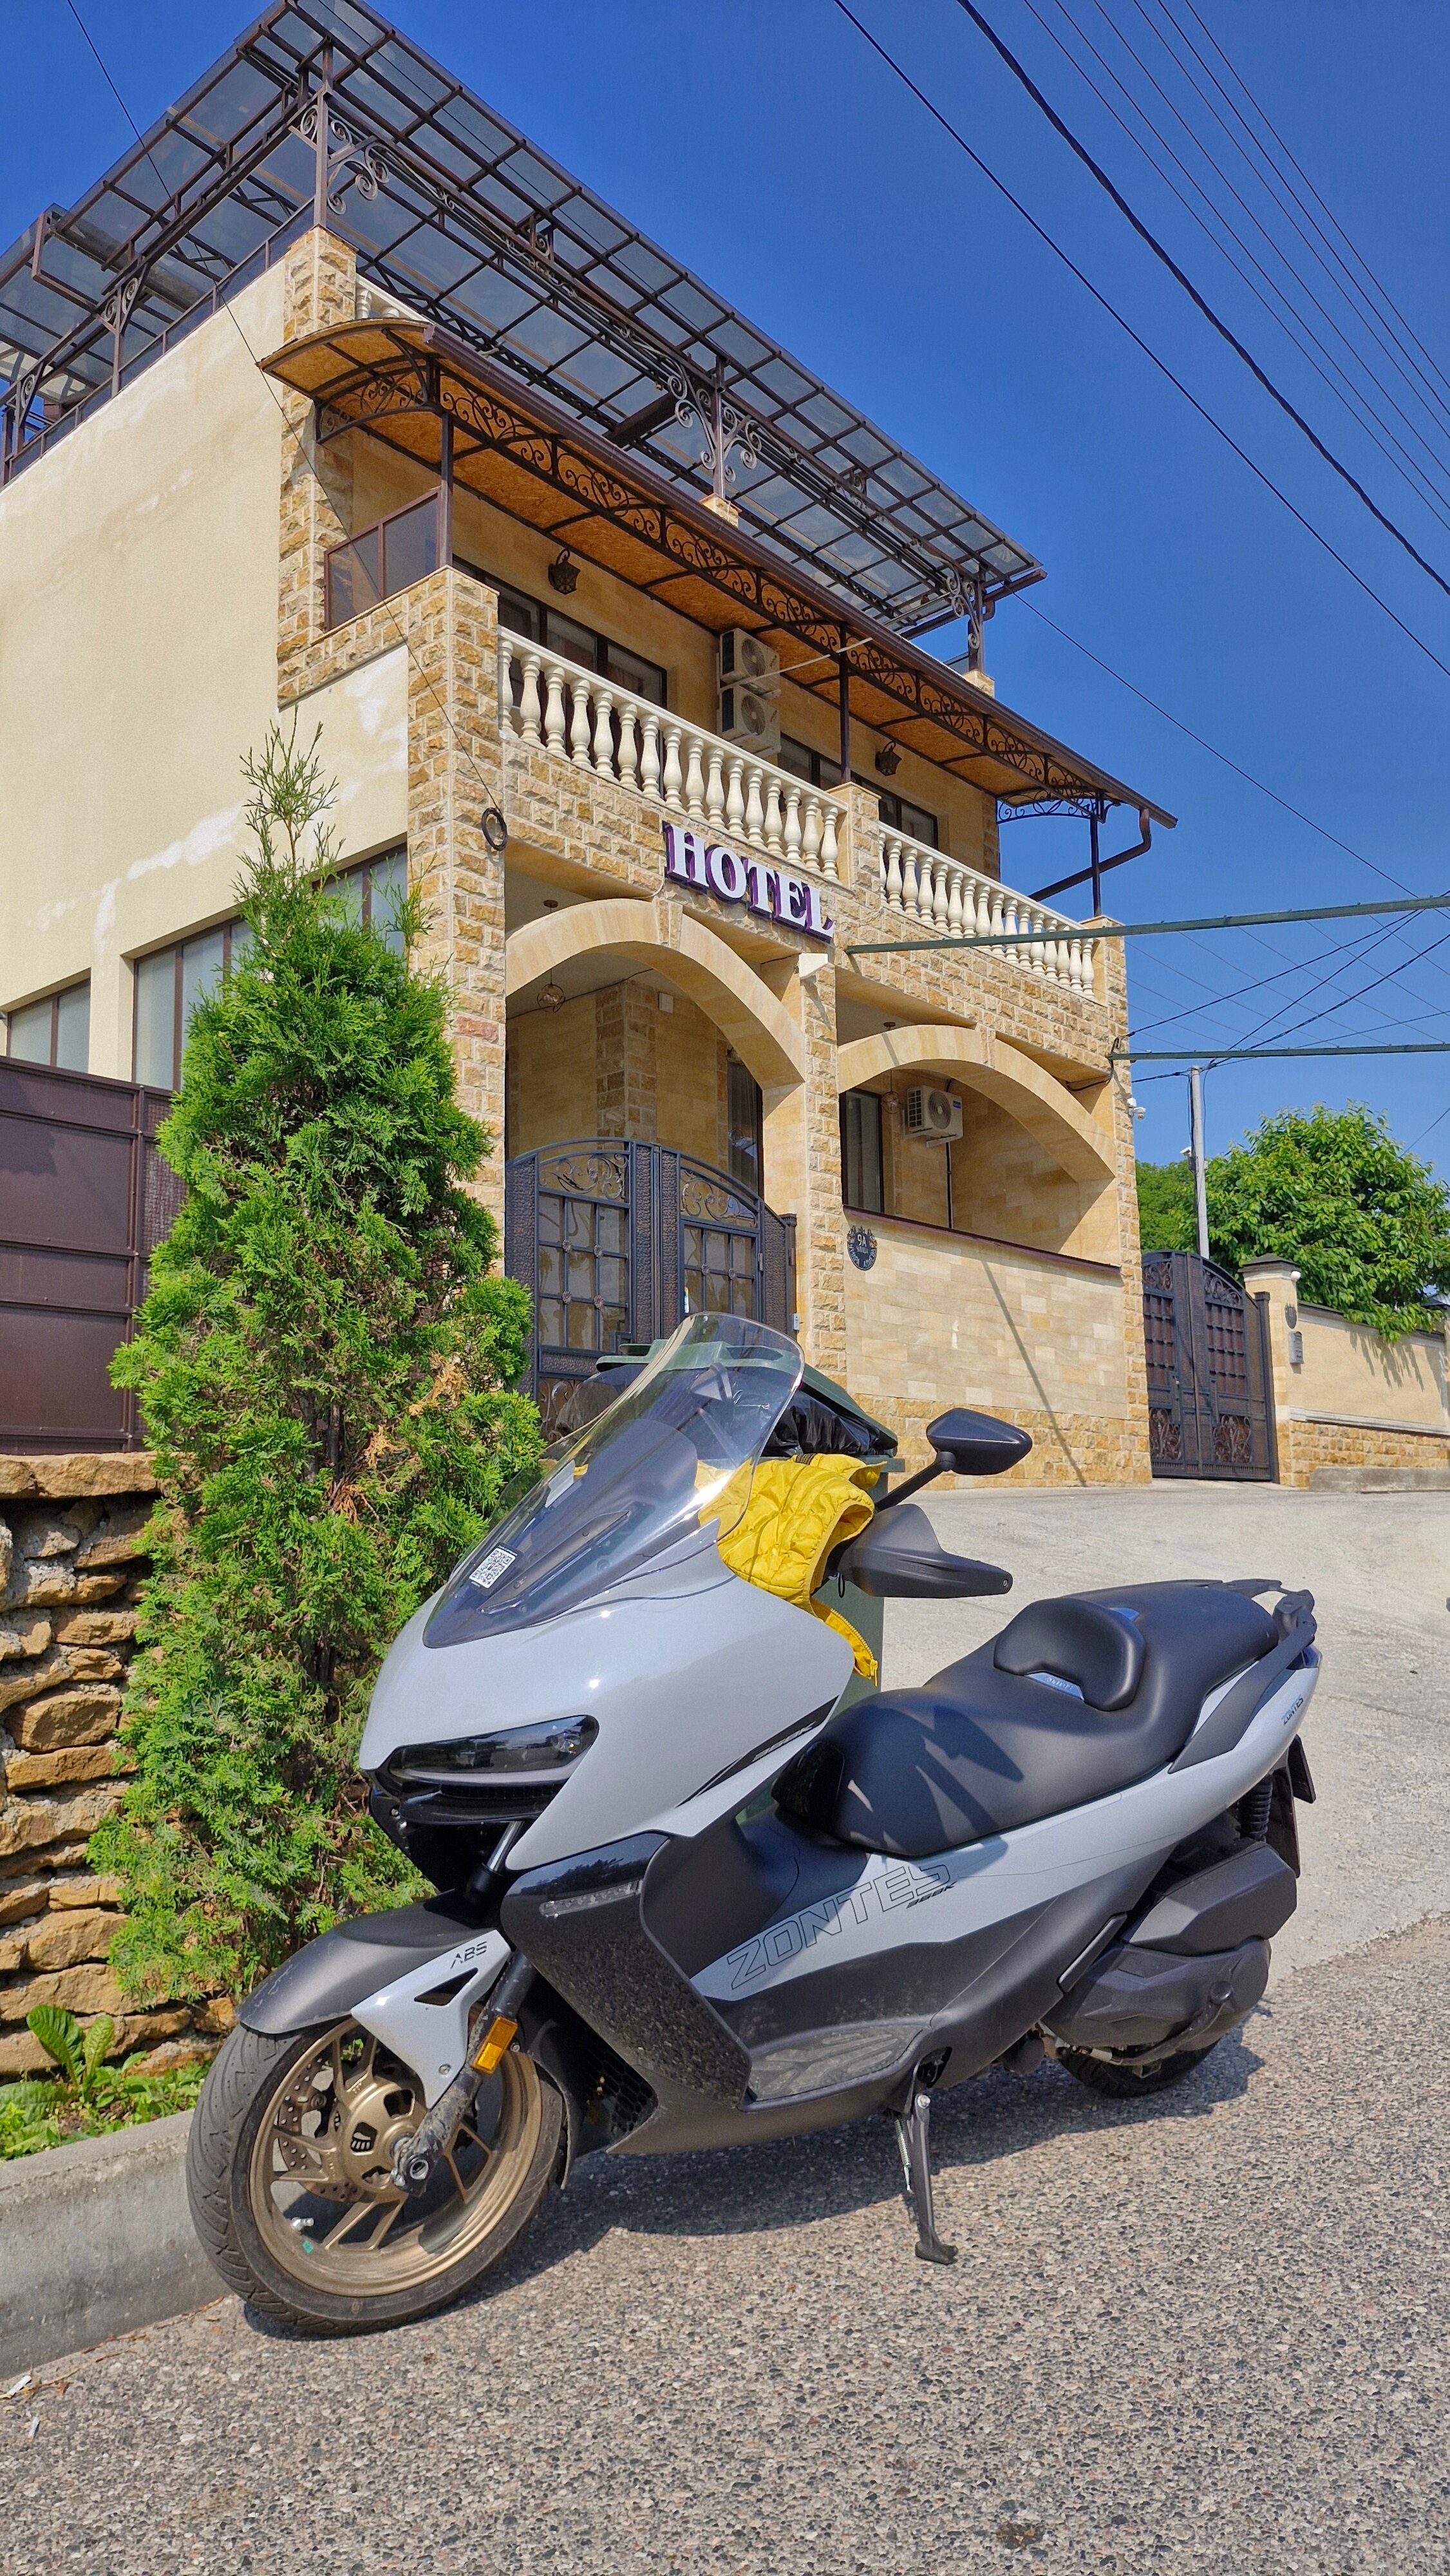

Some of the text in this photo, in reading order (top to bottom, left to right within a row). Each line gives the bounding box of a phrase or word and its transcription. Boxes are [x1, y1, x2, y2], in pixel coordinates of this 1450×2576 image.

[663, 821, 834, 943] HOTEL
[451, 1941, 487, 1969] ABS
[727, 1864, 951, 1990] ZONTES
